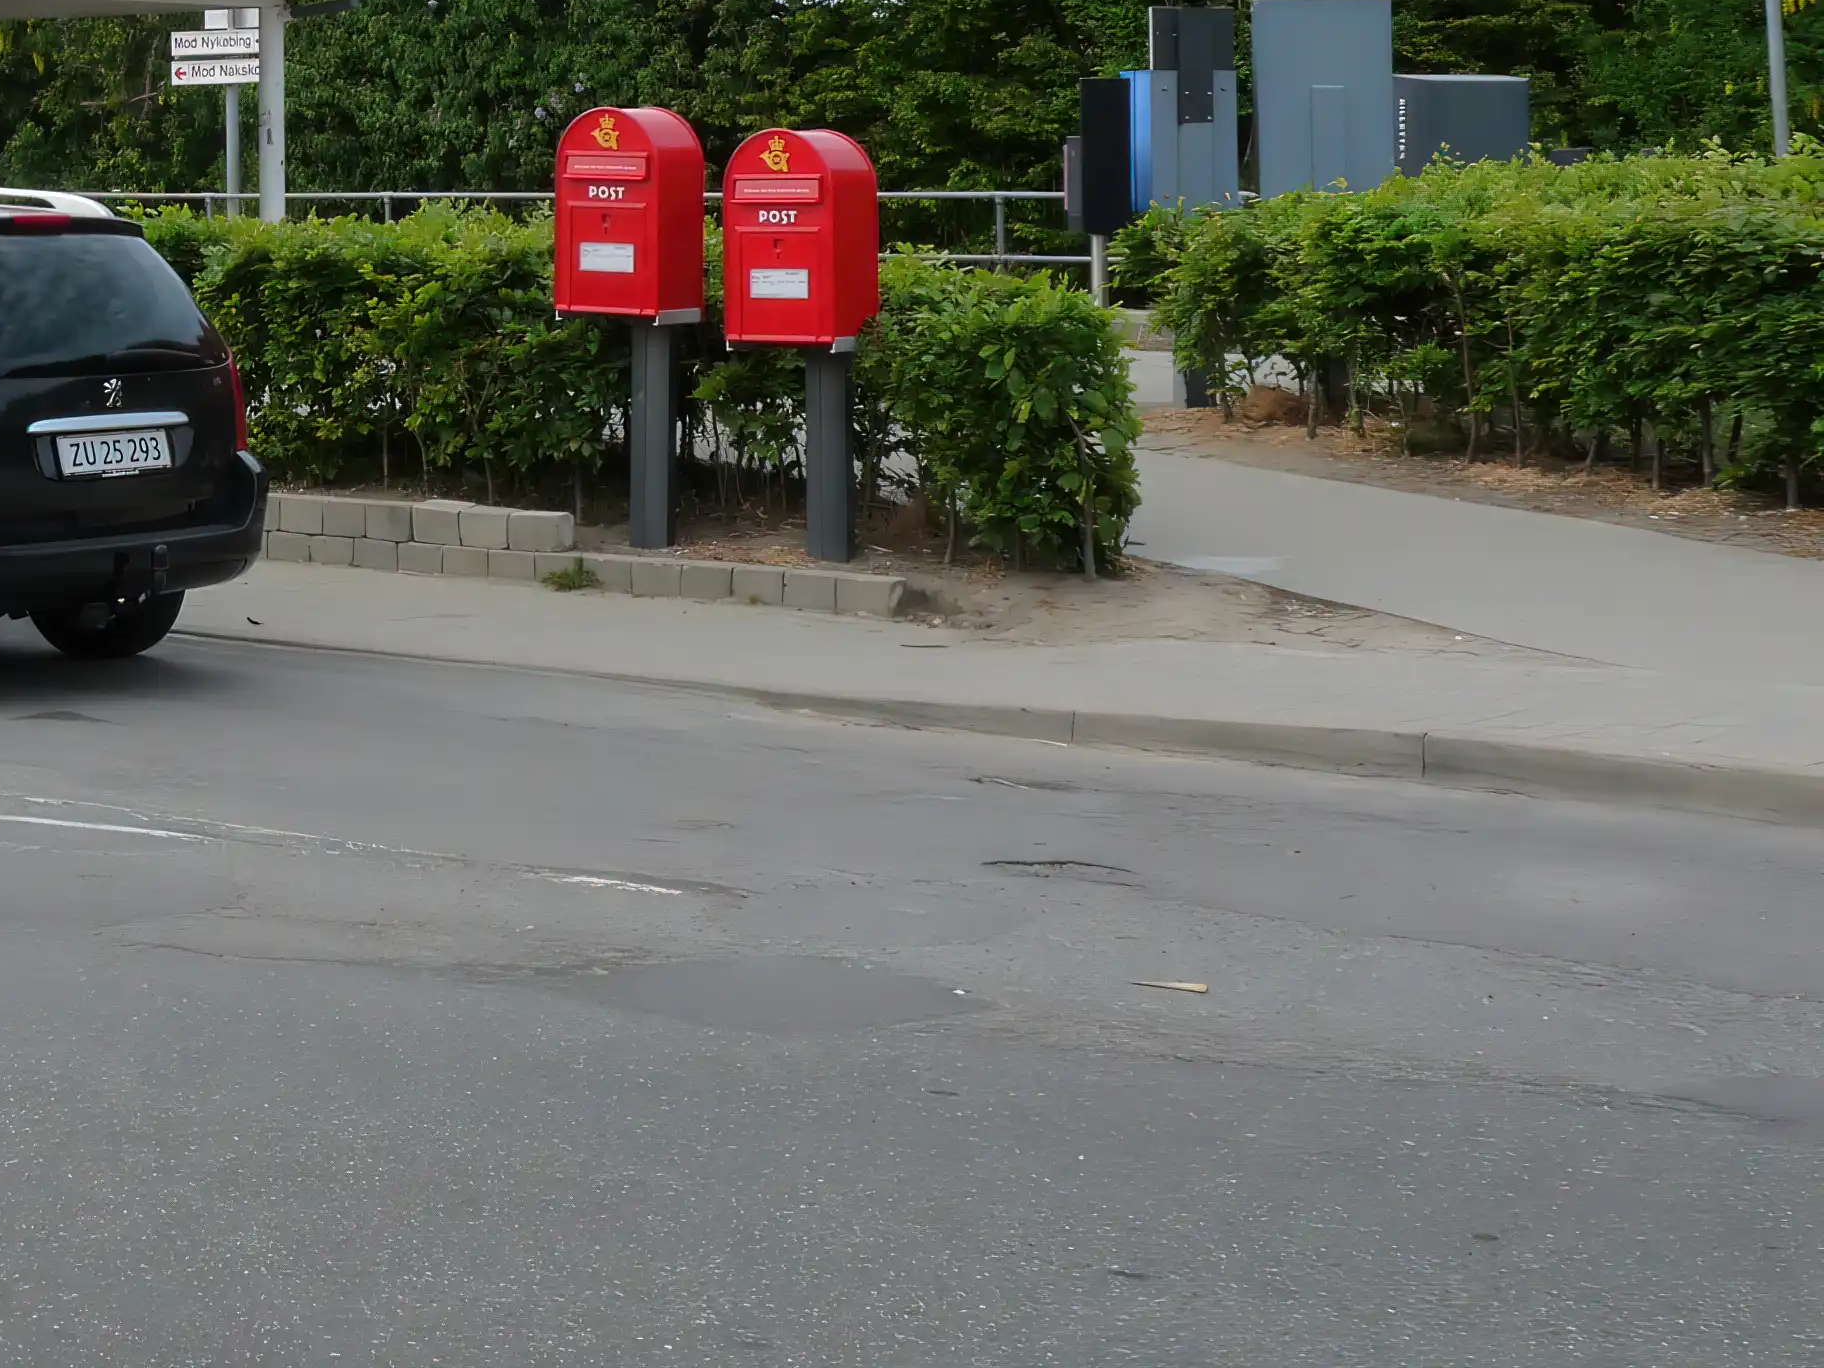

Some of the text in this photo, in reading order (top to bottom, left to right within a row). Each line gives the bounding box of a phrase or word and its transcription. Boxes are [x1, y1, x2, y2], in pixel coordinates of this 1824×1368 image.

[174, 37, 197, 49] Mod
[191, 65, 216, 78] Mod
[588, 185, 625, 200] POST
[759, 210, 797, 224] POST
[69, 436, 161, 467] ZU 25 293
